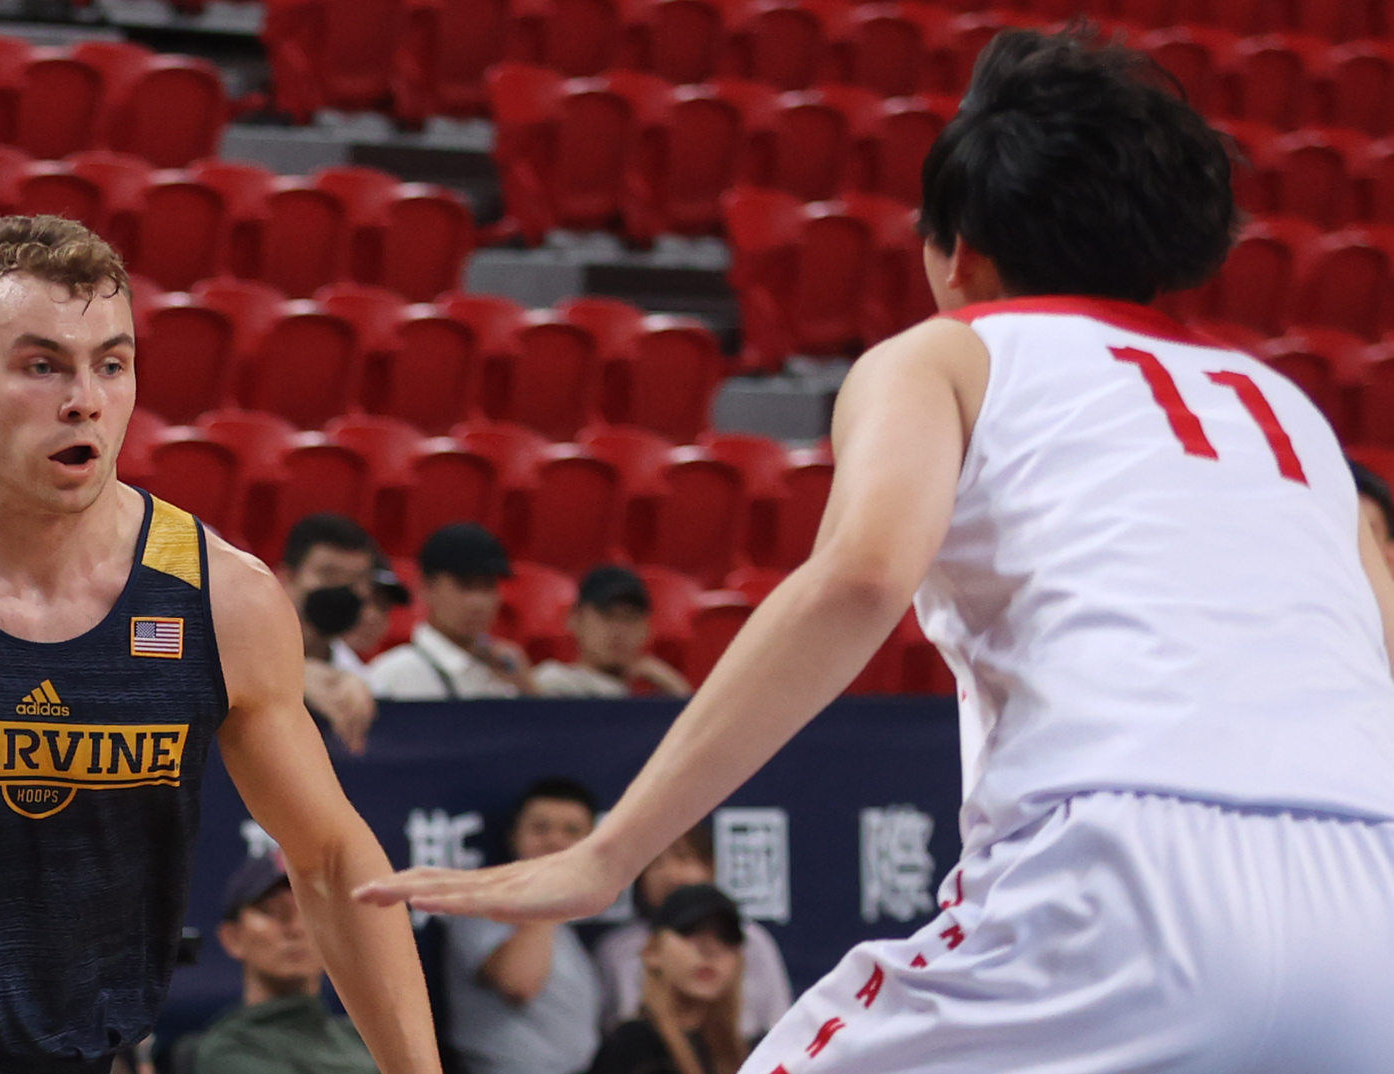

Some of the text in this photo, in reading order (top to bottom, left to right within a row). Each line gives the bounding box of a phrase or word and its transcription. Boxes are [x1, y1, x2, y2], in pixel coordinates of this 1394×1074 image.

[1106, 346, 1310, 490] 11
[16, 702, 70, 717] adidas
[16, 788, 60, 804] HOOPS
